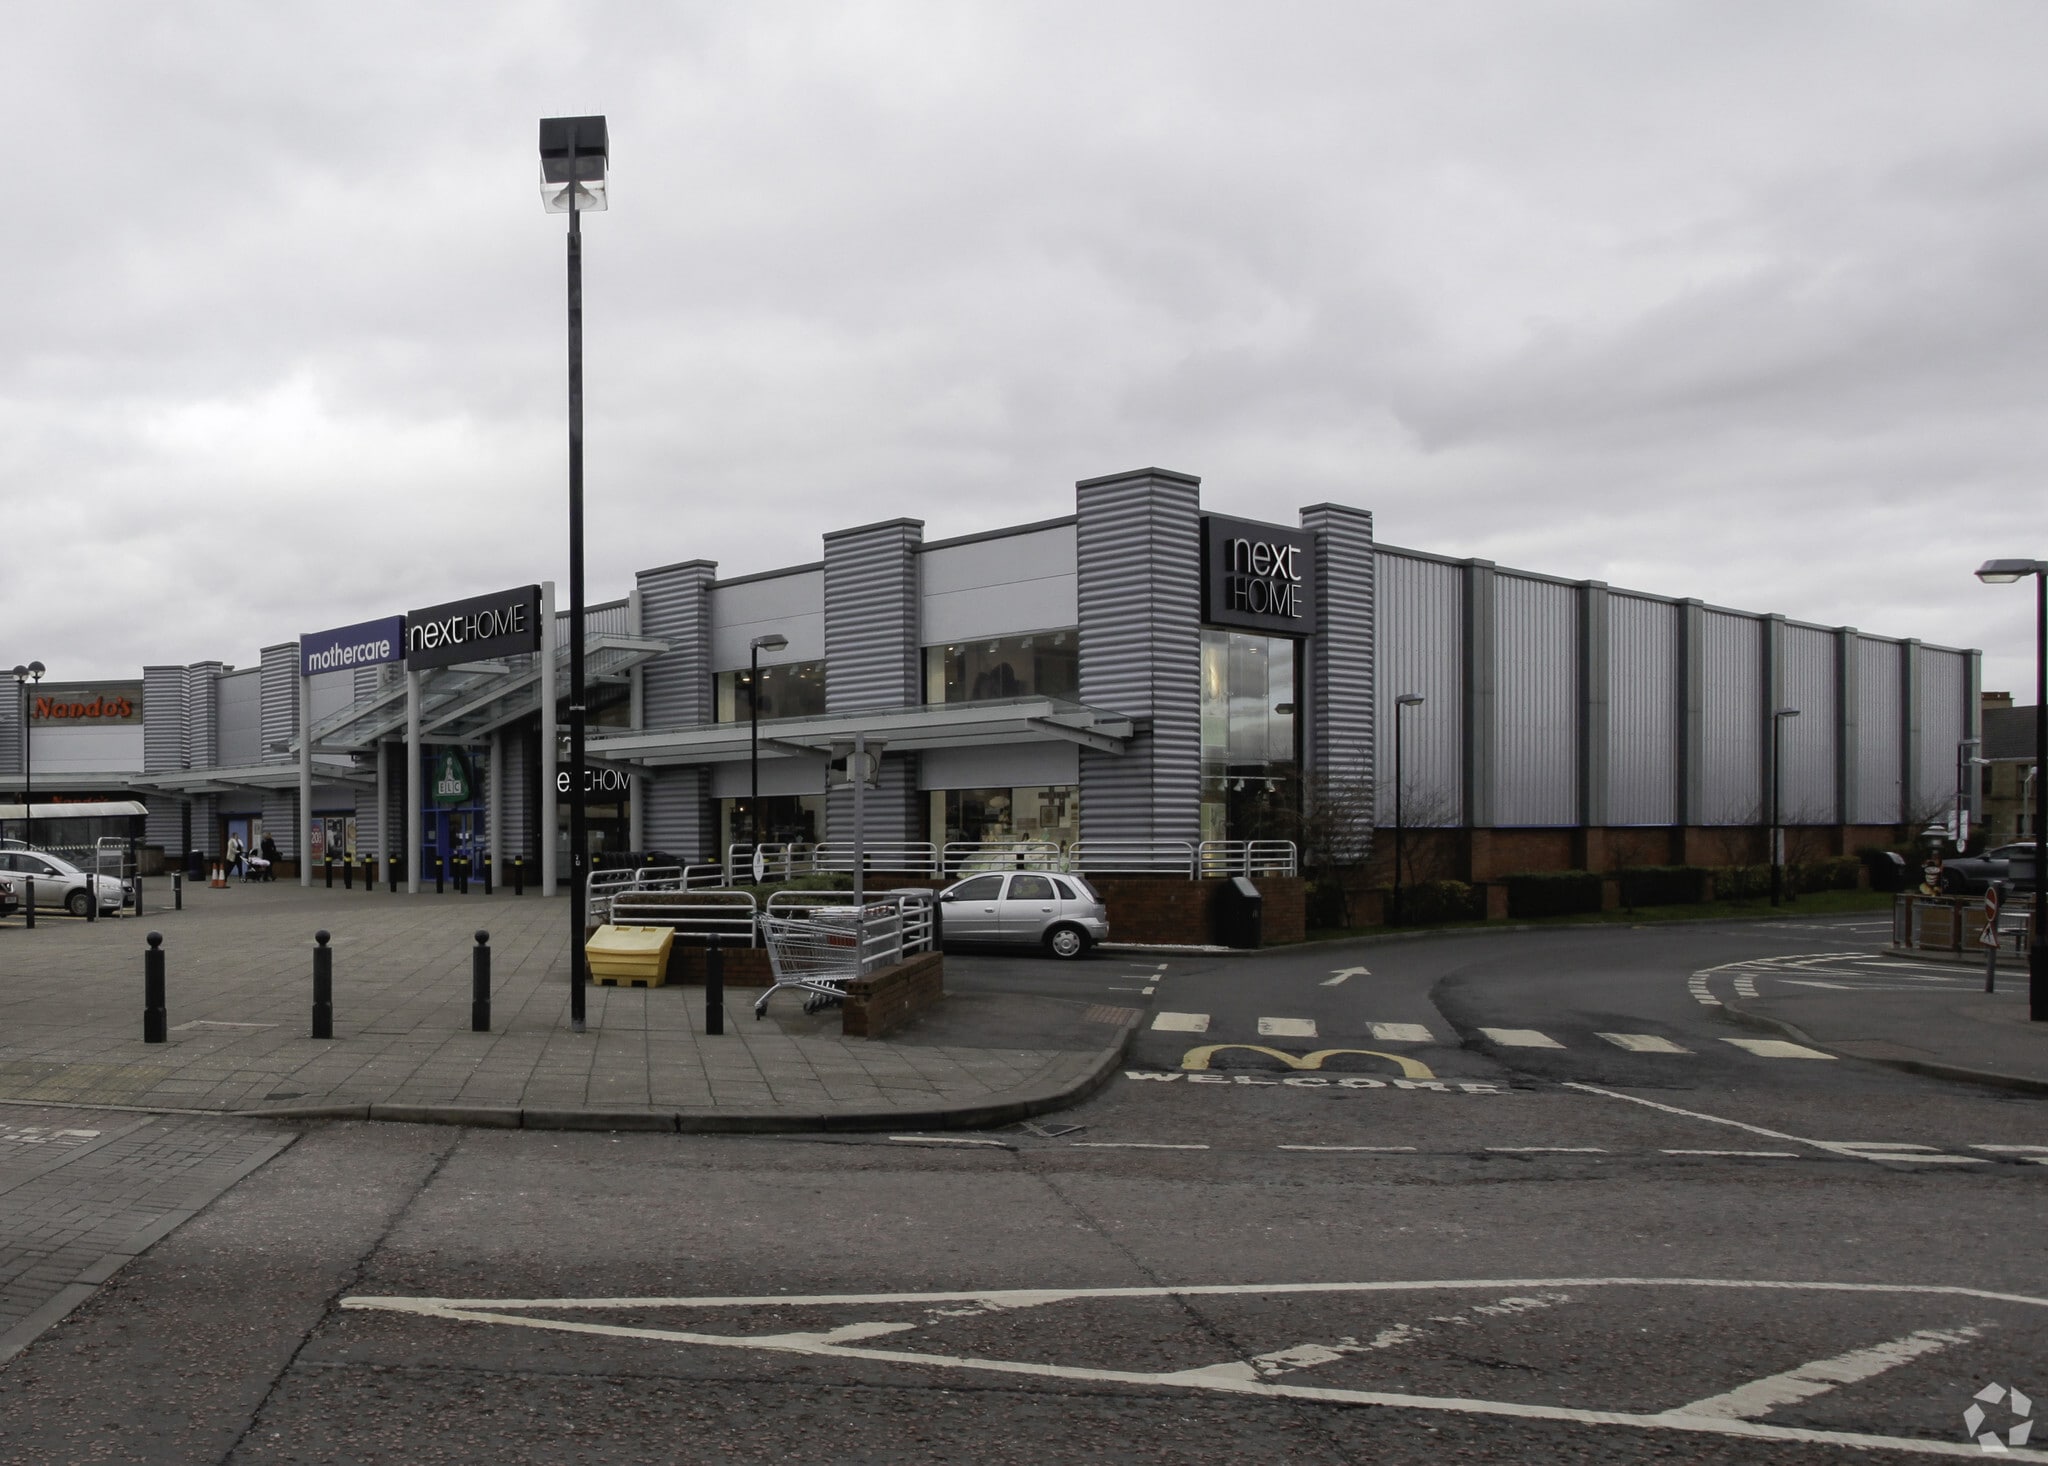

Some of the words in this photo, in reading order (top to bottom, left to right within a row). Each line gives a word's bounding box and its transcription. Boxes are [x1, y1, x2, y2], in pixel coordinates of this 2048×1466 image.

[1233, 538, 1302, 581] next
[1234, 576, 1303, 618] HOME
[308, 639, 390, 672] mothercare
[32, 695, 133, 720] Nando's
[1124, 1071, 1513, 1095] WELCOME
